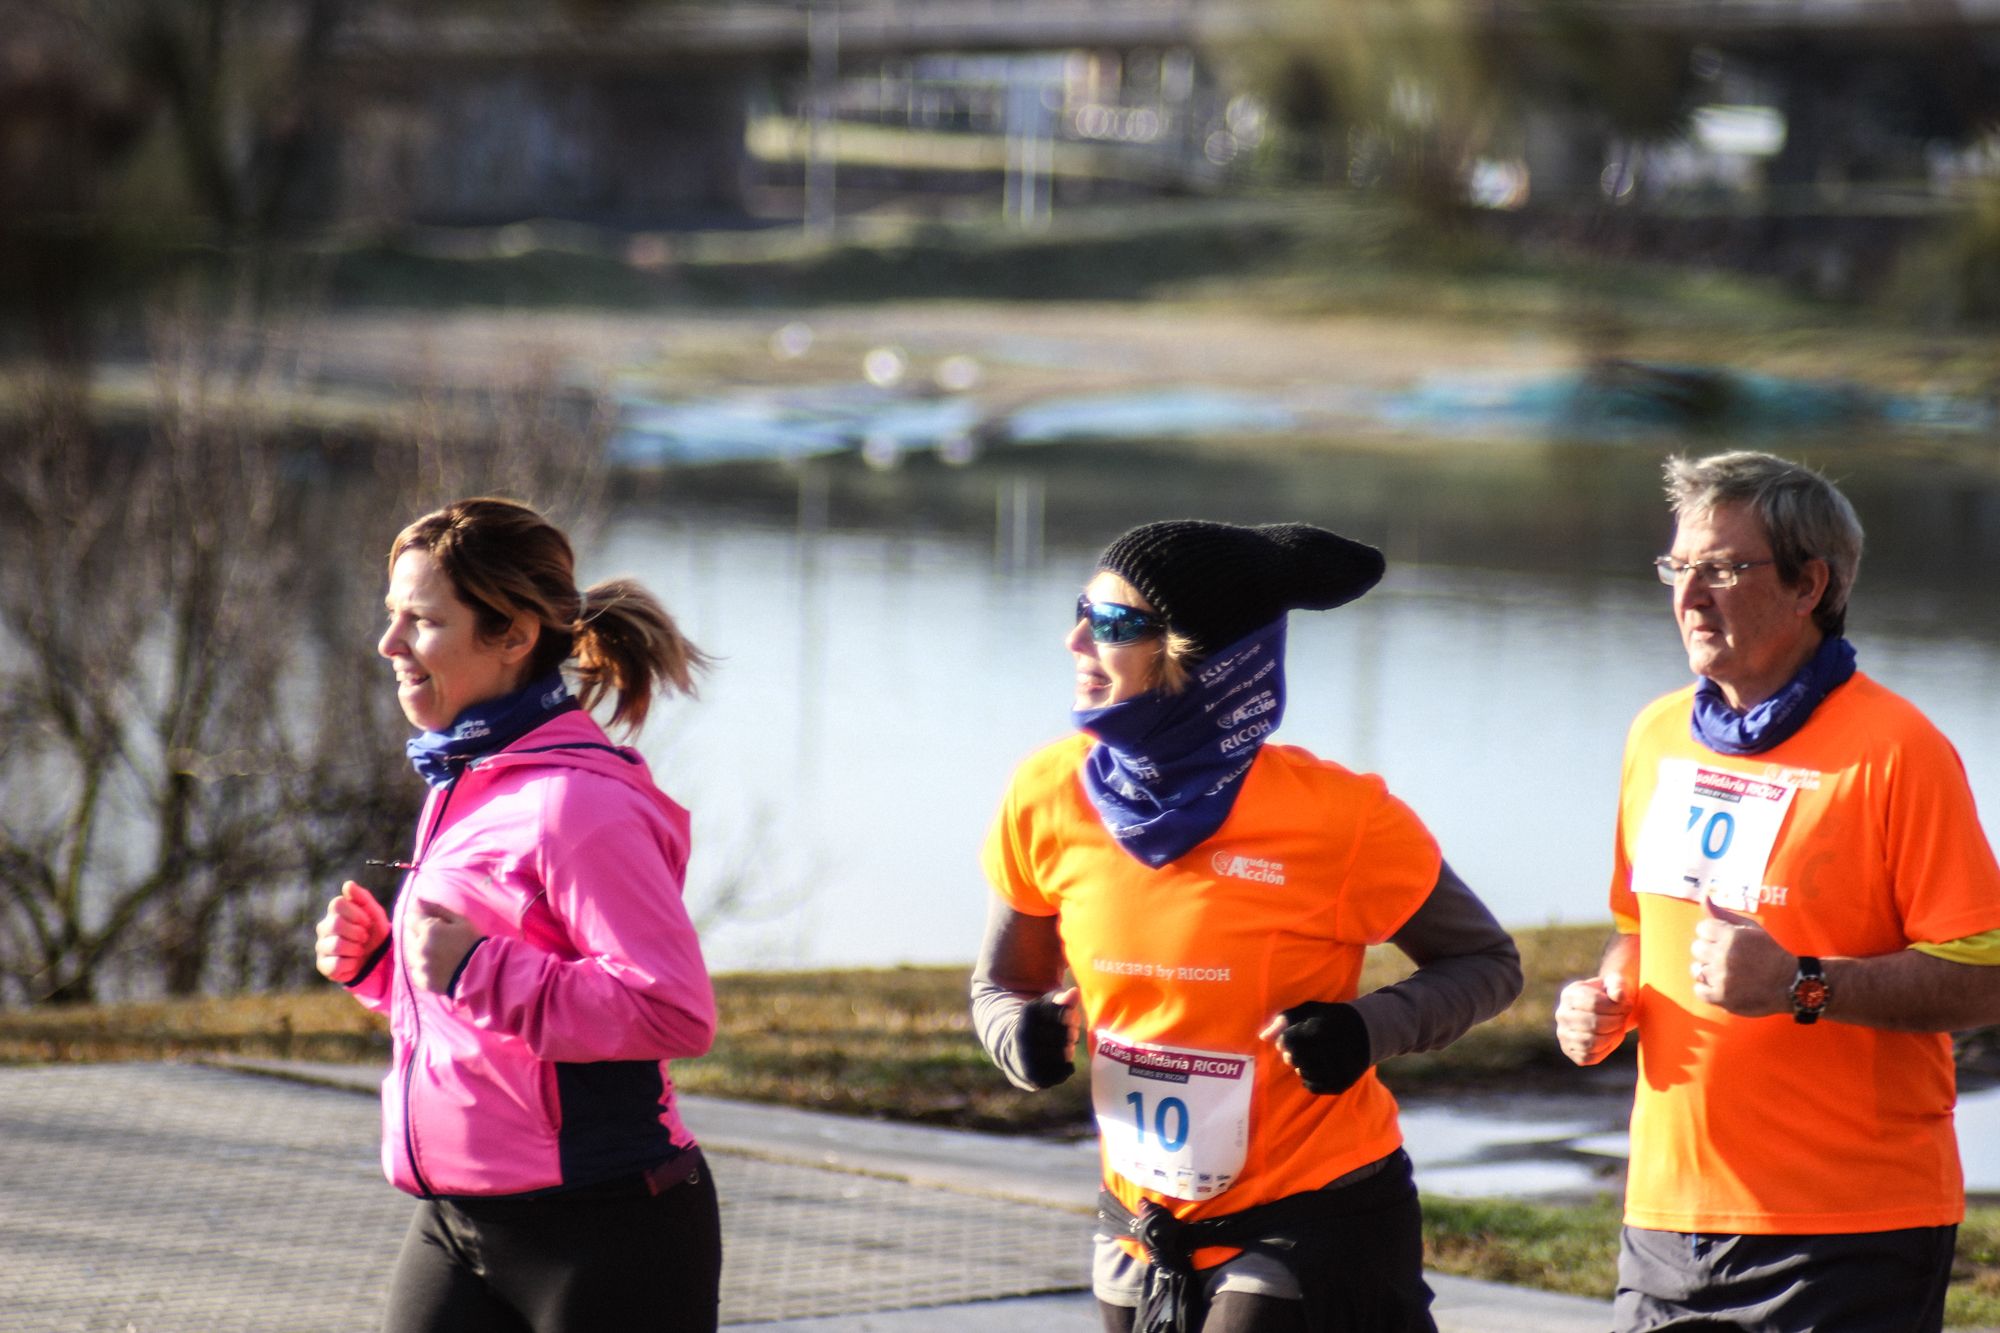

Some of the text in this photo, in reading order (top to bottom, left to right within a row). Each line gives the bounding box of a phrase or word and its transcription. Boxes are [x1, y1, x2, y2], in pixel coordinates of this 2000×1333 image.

[1220, 718, 1272, 753] RICOH
[1155, 964, 1175, 981] by
[1177, 967, 1231, 981] RICOH
[1192, 1060, 1240, 1076] RICOH
[1126, 1091, 1189, 1153] 10
